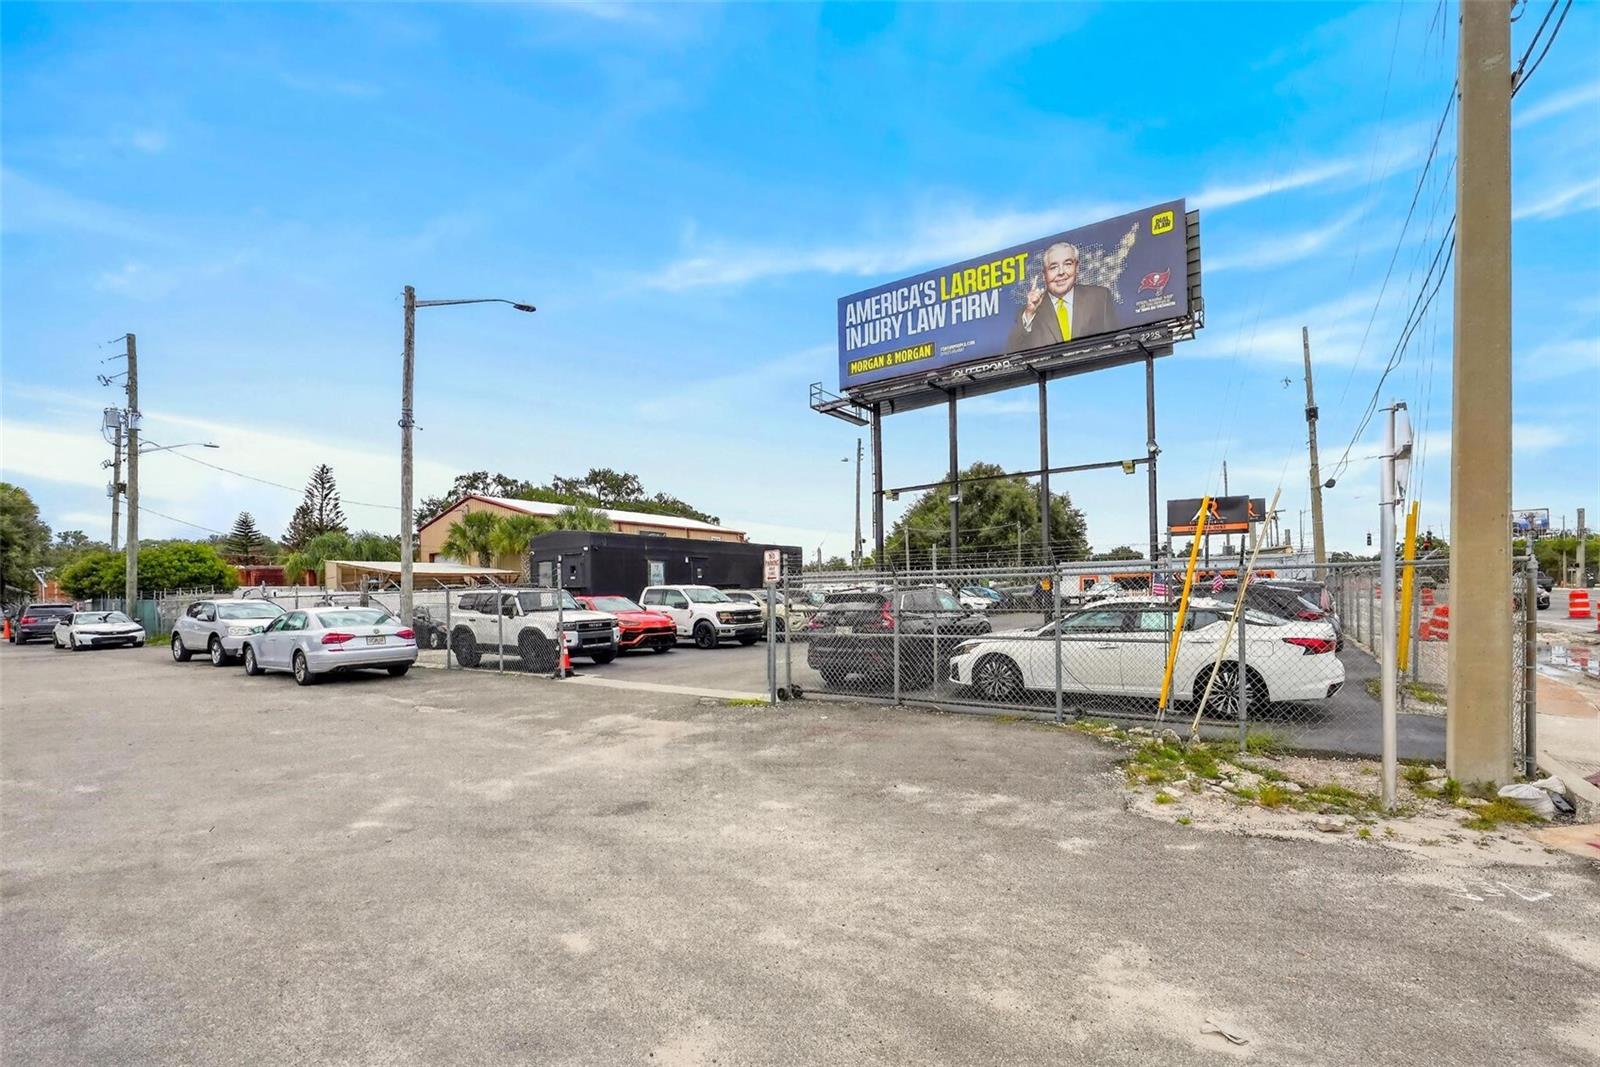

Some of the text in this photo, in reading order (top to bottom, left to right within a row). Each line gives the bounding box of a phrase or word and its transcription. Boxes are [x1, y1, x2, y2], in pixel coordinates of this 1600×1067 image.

[845, 253, 1028, 326] AMERICA'S LARGEST
[846, 314, 902, 350] INJURY
[907, 302, 946, 335] LAW
[952, 290, 1000, 325] FIRM
[851, 356, 884, 373] MORGAN
[887, 353, 892, 365] &
[895, 344, 932, 363] MORGAN
